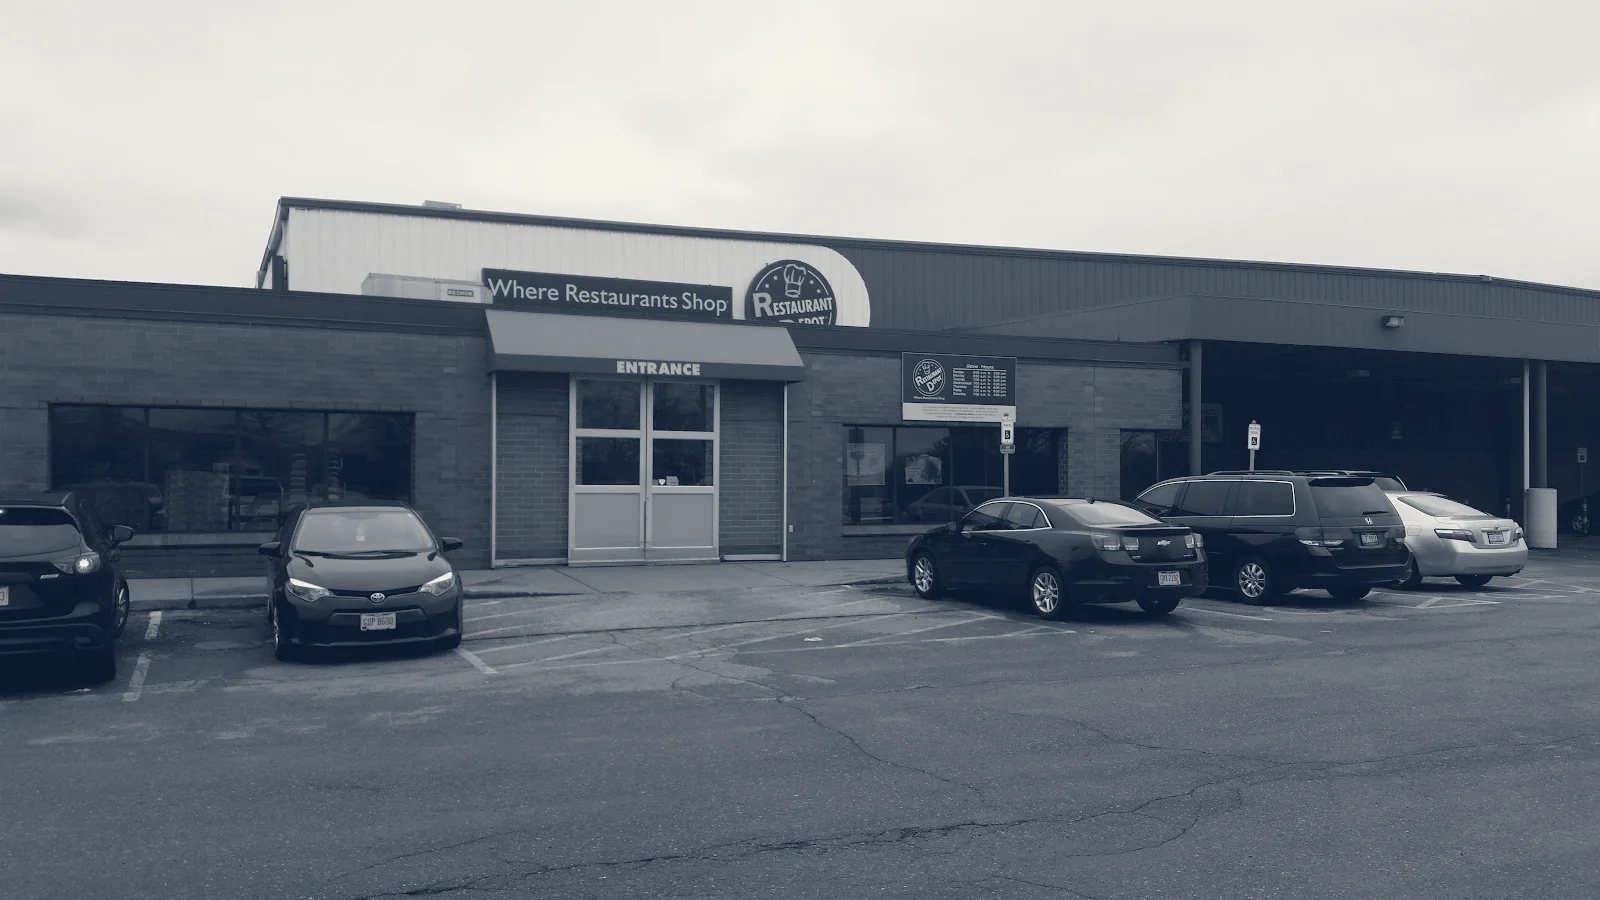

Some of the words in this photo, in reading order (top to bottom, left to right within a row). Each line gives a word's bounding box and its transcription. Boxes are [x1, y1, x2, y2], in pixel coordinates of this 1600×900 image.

[488, 277, 560, 301] Where
[565, 283, 678, 310] Restaurants
[681, 291, 728, 317] Shop
[752, 292, 833, 317] RESTAURANT
[616, 360, 701, 376] ENTRANCE
